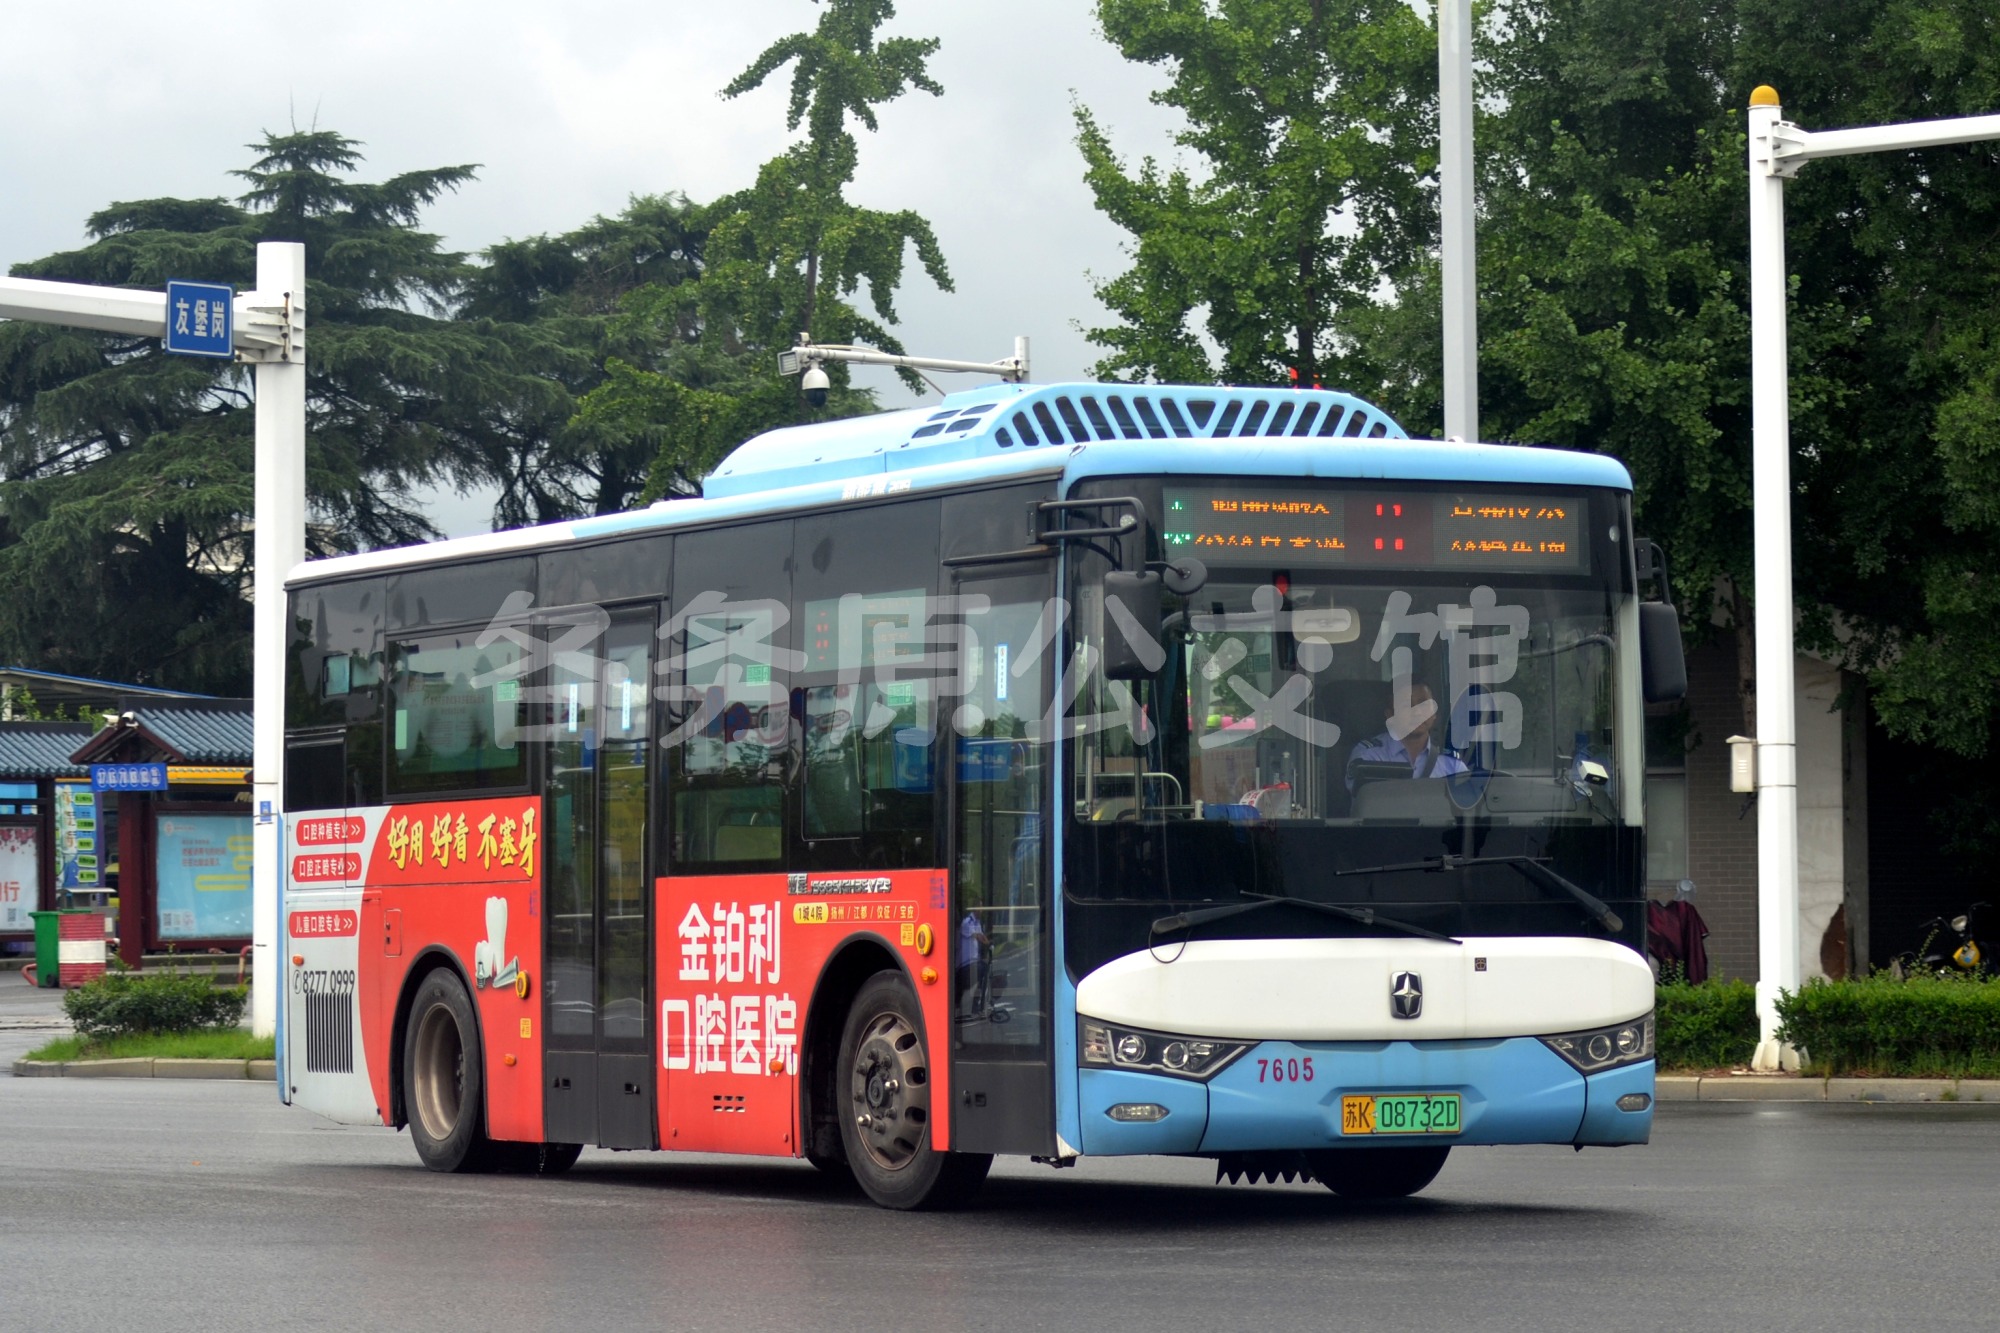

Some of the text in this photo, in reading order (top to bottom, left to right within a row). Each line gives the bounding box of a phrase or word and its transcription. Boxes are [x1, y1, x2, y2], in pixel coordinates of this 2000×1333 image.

[303, 821, 349, 841] 口腔种植专业
[387, 806, 537, 877] 好用 好看 不塞牙
[299, 857, 345, 877] 口腔正畸专业
[0, 881, 20, 902] 行
[296, 914, 341, 934] 儿童口腔专业
[678, 901, 781, 984] 金铂利
[662, 993, 798, 1076] 口腔医院
[1257, 1057, 1314, 1083] 7605
